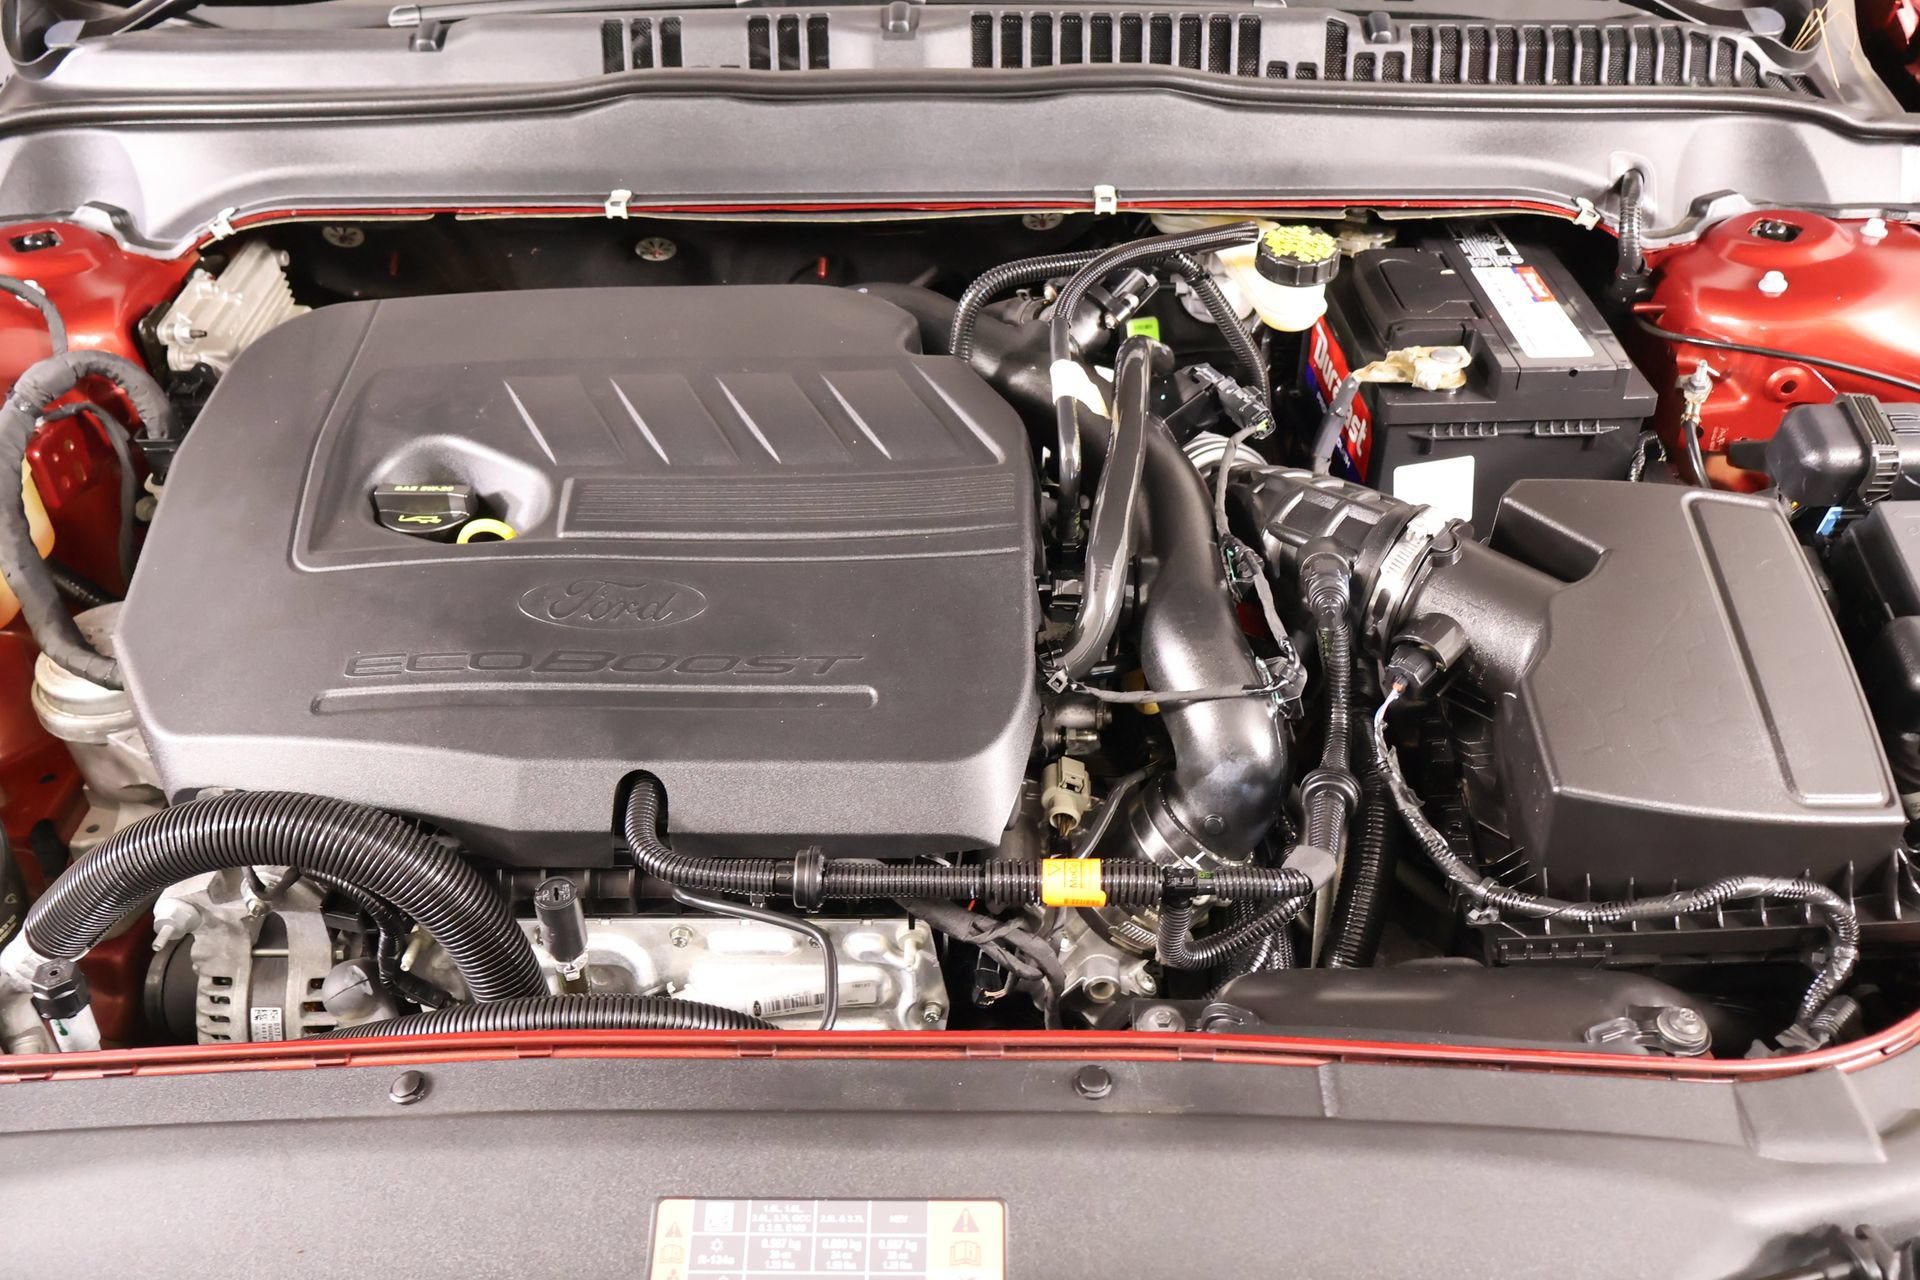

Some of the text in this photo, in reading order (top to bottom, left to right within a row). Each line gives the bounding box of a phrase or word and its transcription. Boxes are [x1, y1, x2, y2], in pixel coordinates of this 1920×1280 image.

[548, 581, 679, 622] Ford
[344, 649, 864, 679] ECOBOOST
[697, 1254, 735, 1265] R-134a
